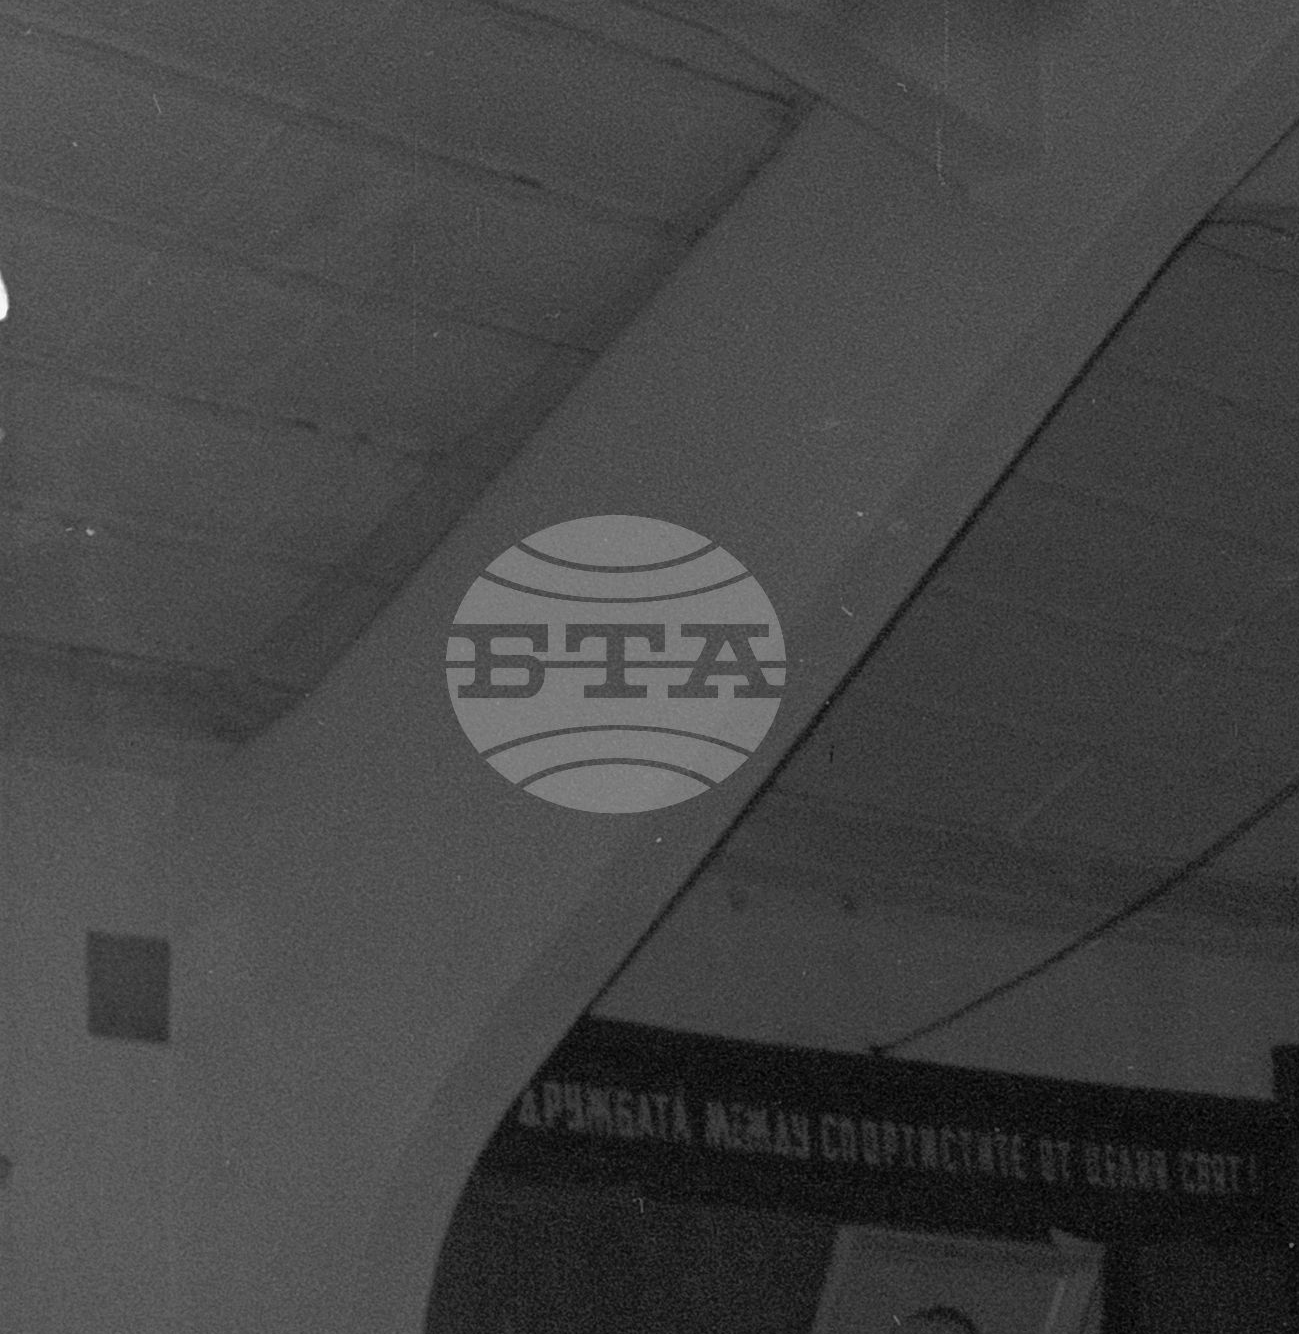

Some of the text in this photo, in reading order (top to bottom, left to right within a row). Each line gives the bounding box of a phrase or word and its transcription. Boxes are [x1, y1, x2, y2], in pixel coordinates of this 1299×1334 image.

[518, 1081, 691, 1144] ДРУЖБАТА
[703, 1100, 811, 1160] МЕЖДУ
[1038, 1134, 1072, 1184] ОТ
